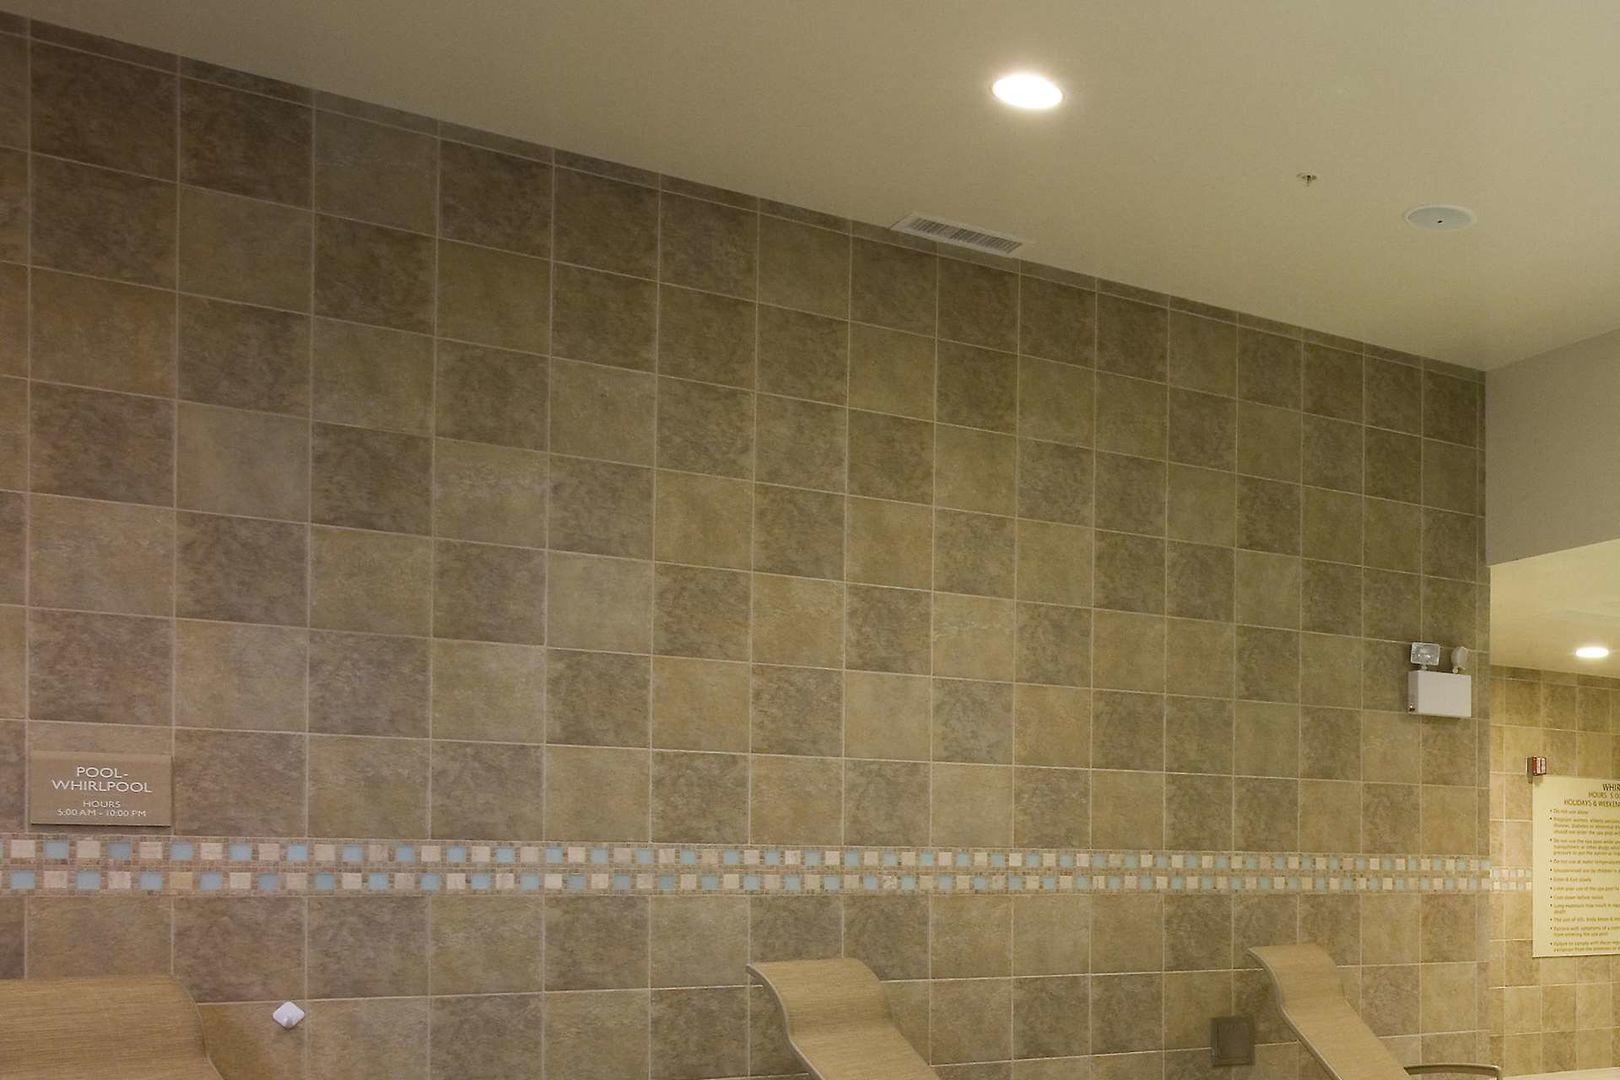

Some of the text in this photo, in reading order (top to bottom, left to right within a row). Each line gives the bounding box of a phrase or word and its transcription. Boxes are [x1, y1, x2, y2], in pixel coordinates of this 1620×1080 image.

[76, 766, 129, 779] POOL-
[51, 779, 152, 793] WHIRLPOOL
[83, 800, 121, 808] HOURS
